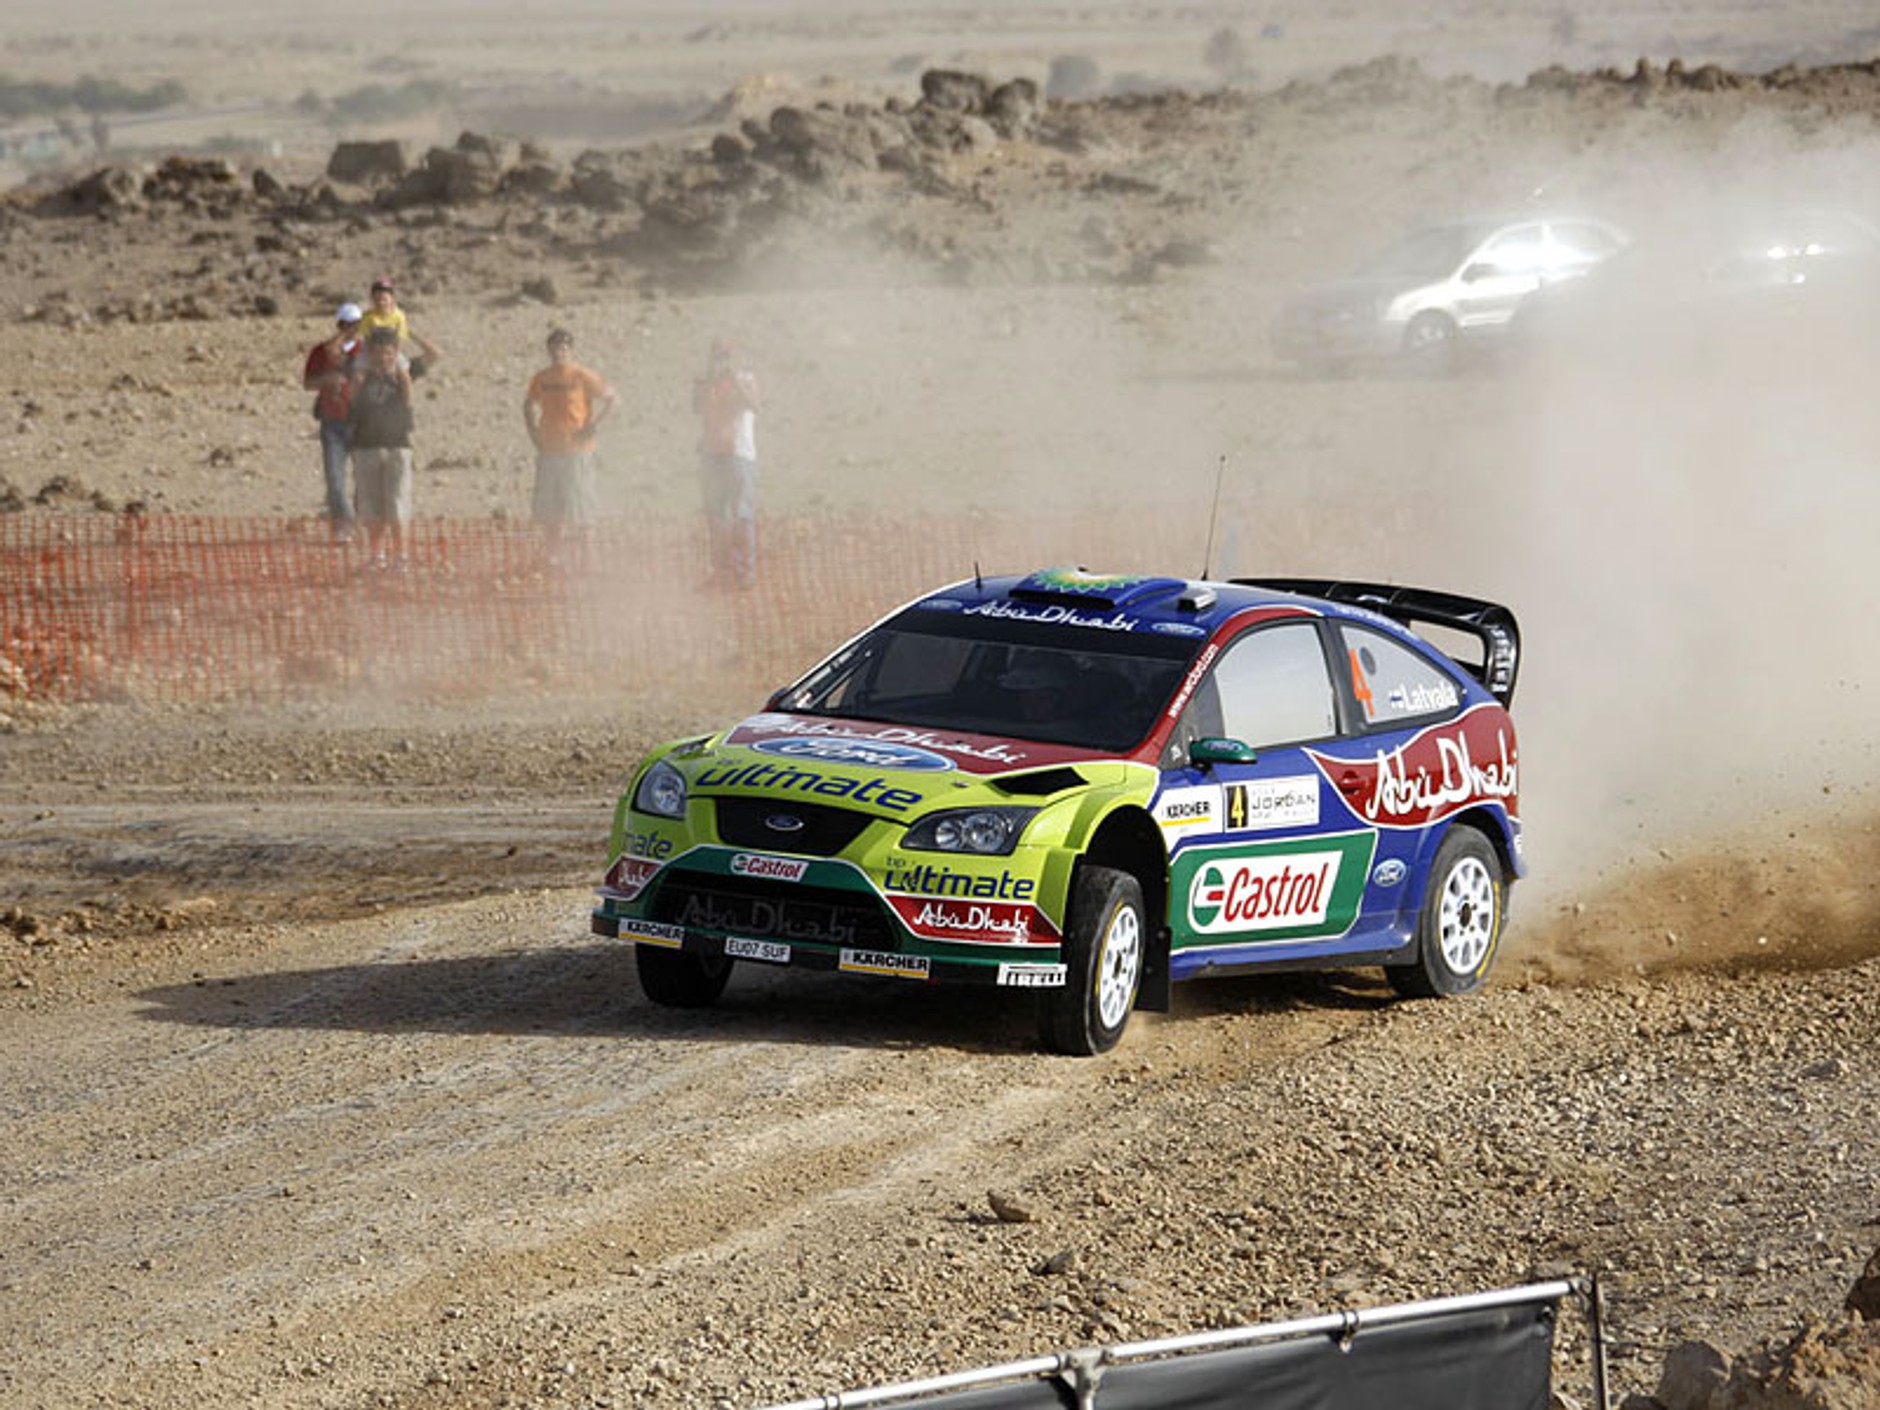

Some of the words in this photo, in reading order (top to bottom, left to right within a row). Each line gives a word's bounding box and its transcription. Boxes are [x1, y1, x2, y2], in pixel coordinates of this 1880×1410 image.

[1035, 605, 1139, 631] Dhabi
[1349, 647, 1375, 717] 4
[865, 728, 1027, 764] Dhabi
[695, 763, 924, 812] ultimate
[1365, 745, 1446, 819] Abu
[1436, 729, 1518, 803] Dhabi
[1231, 786, 1244, 828] 4
[1252, 794, 1315, 810] JORDAN
[747, 857, 803, 879] Castrol
[884, 865, 1035, 900] ultimate
[1224, 862, 1329, 922] Castrol
[966, 905, 1029, 933] Dhabi
[729, 940, 759, 954] EU07
[762, 944, 789, 959] SUF
